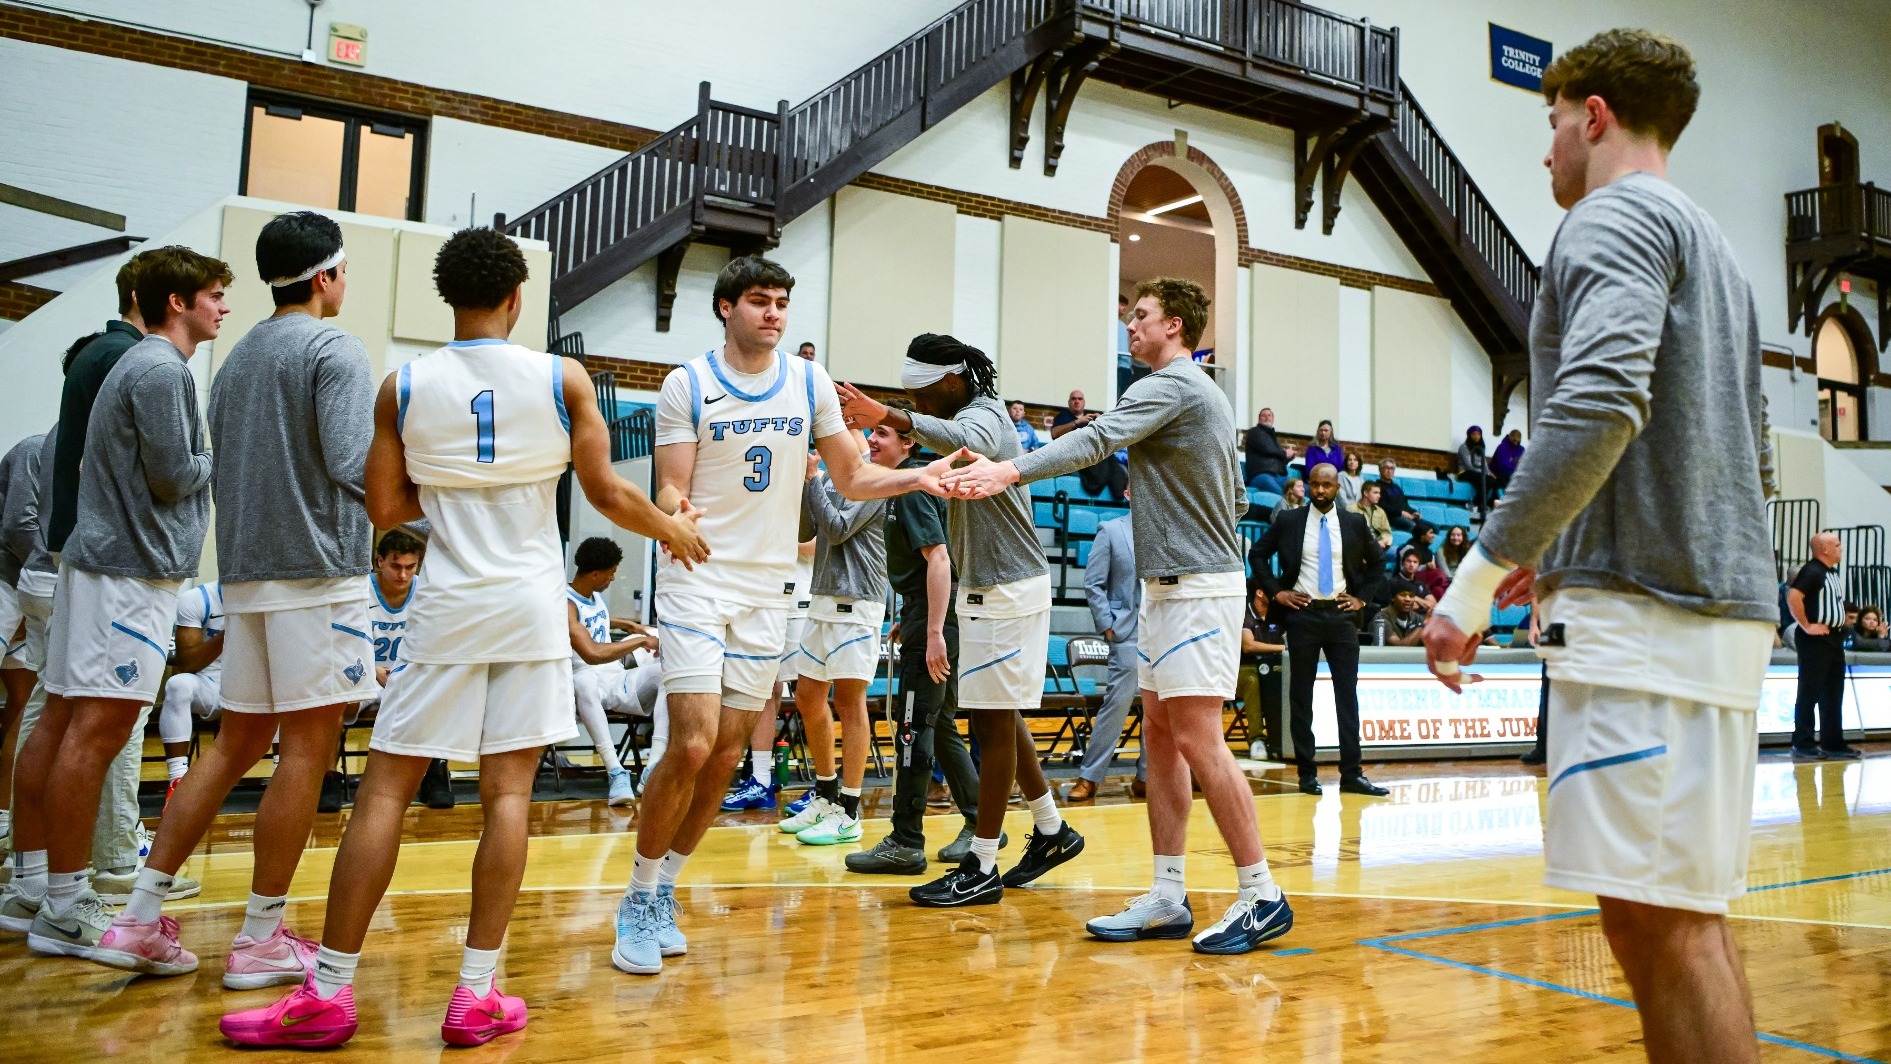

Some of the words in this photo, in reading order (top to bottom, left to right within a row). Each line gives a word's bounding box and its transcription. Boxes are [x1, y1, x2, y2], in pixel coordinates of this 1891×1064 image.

[336, 40, 361, 62] EXIT
[1502, 45, 1541, 66] TRINITY
[1501, 56, 1543, 78] COLLEGE
[471, 390, 495, 463] 1
[710, 417, 803, 440] TUFTS
[744, 446, 772, 492] 3
[1073, 640, 1110, 655] Tufts
[1358, 719, 1412, 741] OME
[1418, 719, 1442, 740] OF
[1449, 718, 1491, 739] THE
